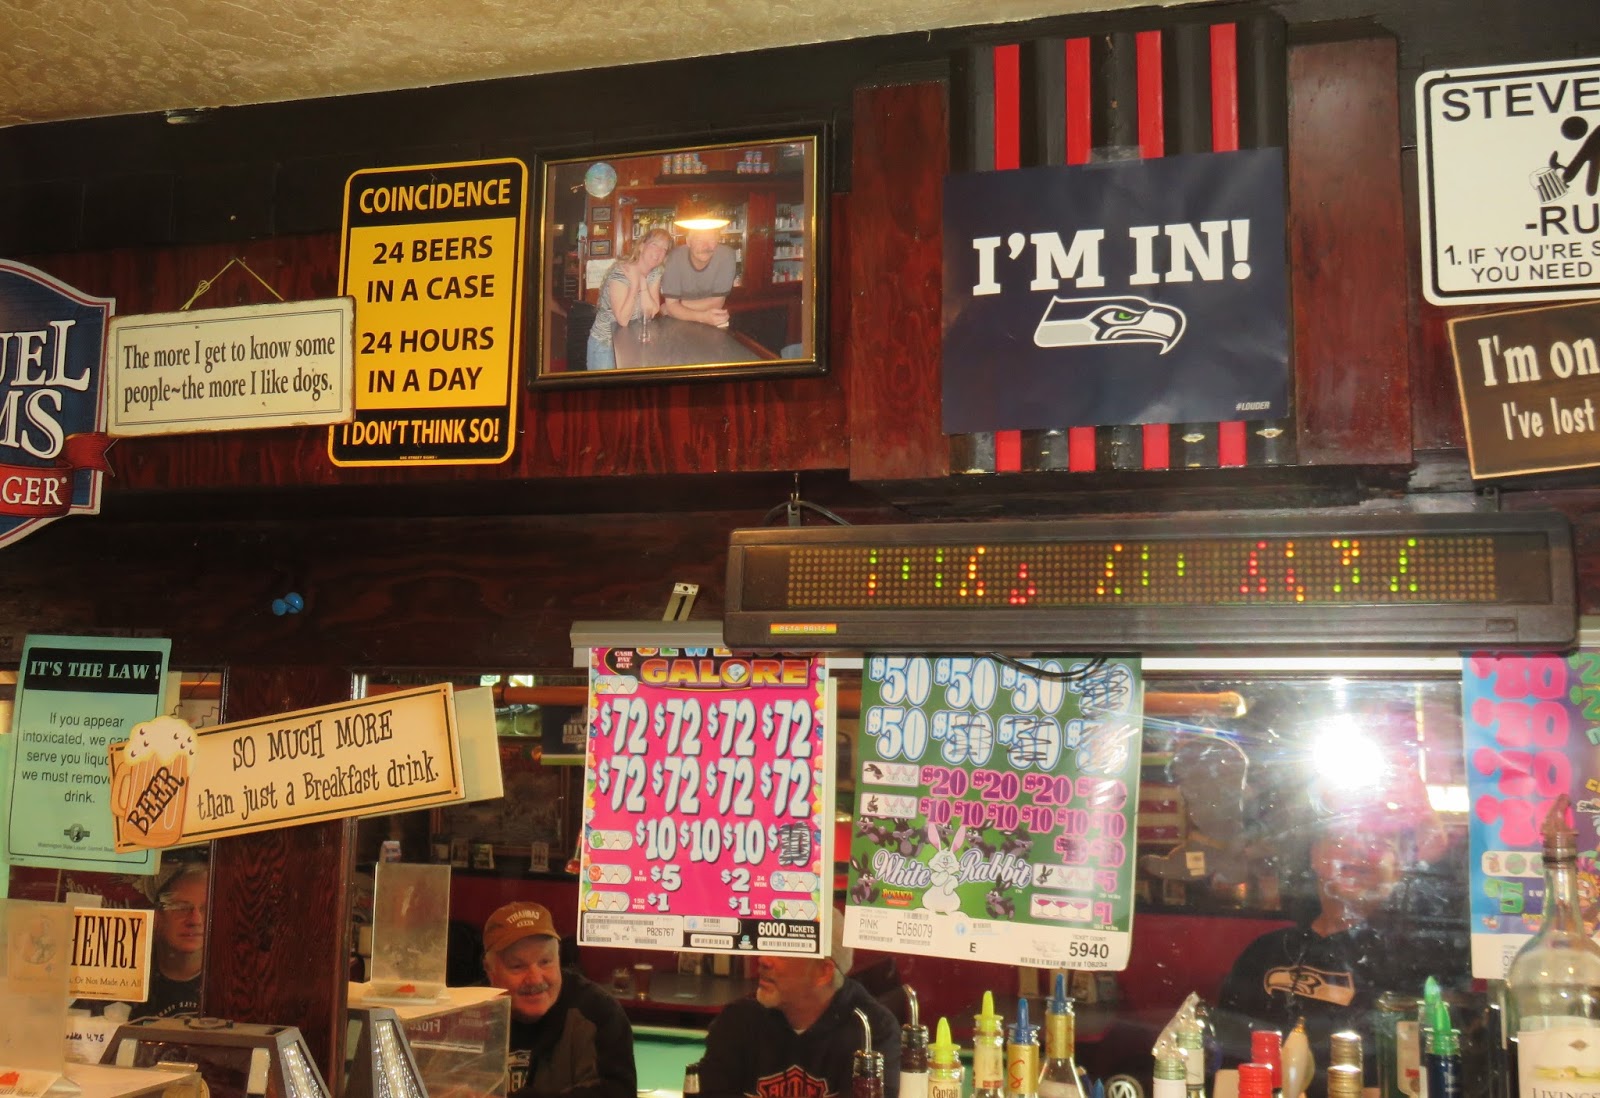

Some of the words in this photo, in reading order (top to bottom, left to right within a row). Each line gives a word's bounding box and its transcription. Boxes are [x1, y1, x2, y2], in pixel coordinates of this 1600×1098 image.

[1442, 77, 1600, 122] STEVE
[359, 178, 511, 214] COINCIDENCE
[372, 241, 404, 265] 24
[411, 235, 493, 263] BEERS
[972, 228, 1105, 296] I'M
[1129, 219, 1251, 286] IN!
[1468, 248, 1486, 264] IF
[1495, 242, 1582, 262] YOU'RE
[1471, 266, 1520, 283] YOU
[1530, 261, 1593, 280] NEED
[366, 279, 394, 303] IN
[400, 278, 419, 302] A
[426, 274, 495, 300] CASE
[123, 344, 149, 370] The
[153, 345, 190, 367] more
[194, 340, 202, 364] I
[204, 342, 227, 373] get
[231, 341, 246, 362] to
[250, 335, 291, 361] know
[295, 336, 335, 356] some
[360, 331, 392, 354] 24
[400, 326, 494, 353] HOURS
[0, 320, 91, 392] EL
[1477, 335, 1542, 387] I'm
[208, 377, 246, 398] more
[250, 371, 257, 395] I
[260, 370, 289, 394] like
[293, 367, 333, 402] dogs.
[367, 369, 395, 393] IN
[402, 368, 420, 392] A
[428, 366, 483, 392] DAY
[1236, 401, 1270, 412] #LOUDER
[1502, 401, 1544, 441] I've
[1550, 397, 1595, 435] lost
[342, 423, 349, 445] I
[352, 420, 409, 445] DON'T
[411, 418, 469, 444] THINK
[470, 418, 500, 443] SO!
[29, 660, 63, 676] IT'S
[68, 662, 103, 678] THE
[108, 663, 150, 679] LAW
[641, 658, 809, 688] GALORE
[869, 655, 932, 706] $50
[934, 656, 997, 710] $50
[50, 712, 59, 724] If
[60, 714, 81, 729] you
[83, 716, 125, 728] appear
[600, 697, 648, 754] $72
[653, 697, 702, 755] $72
[707, 698, 756, 757] $72
[761, 698, 812, 758] $72
[865, 706, 928, 761] $50
[22, 729, 86, 746] intoxicated,
[90, 736, 106, 746] we
[232, 735, 256, 772] SO
[267, 719, 324, 762] MUCH
[334, 709, 393, 751] MORE
[26, 750, 57, 763] serve
[60, 753, 81, 767] you
[21, 769, 38, 781] we
[41, 770, 69, 783] must
[197, 789, 235, 821] than
[241, 781, 278, 820] just
[286, 782, 296, 806] a
[301, 762, 380, 803] Breakfast
[386, 749, 440, 788] drink.
[599, 755, 647, 812] $72
[652, 756, 701, 813] $72
[705, 756, 755, 816] $72
[760, 758, 811, 817] $72
[920, 765, 968, 799] $20
[971, 769, 1021, 802] $20
[1022, 773, 1073, 806] $20
[64, 790, 96, 804] drink.
[127, 766, 185, 836] BEER
[919, 797, 950, 825] $10
[954, 800, 985, 829] $10
[986, 802, 1019, 831] $10
[1020, 805, 1053, 833] $10
[1055, 808, 1090, 836] $10
[635, 816, 677, 861] $10
[679, 818, 722, 863] $10
[723, 819, 765, 865] $10
[650, 864, 682, 891] $5
[721, 868, 751, 892] $2
[872, 848, 931, 888] White
[957, 847, 1033, 888] Rabbit
[647, 893, 670, 912] $1
[728, 896, 751, 916] $1
[757, 921, 787, 937] 6000
[788, 925, 815, 934] TICKETS
[860, 918, 878, 929] PINK
[896, 921, 932, 938] E056079
[970, 942, 977, 953] E
[1069, 941, 1109, 959] 5940
